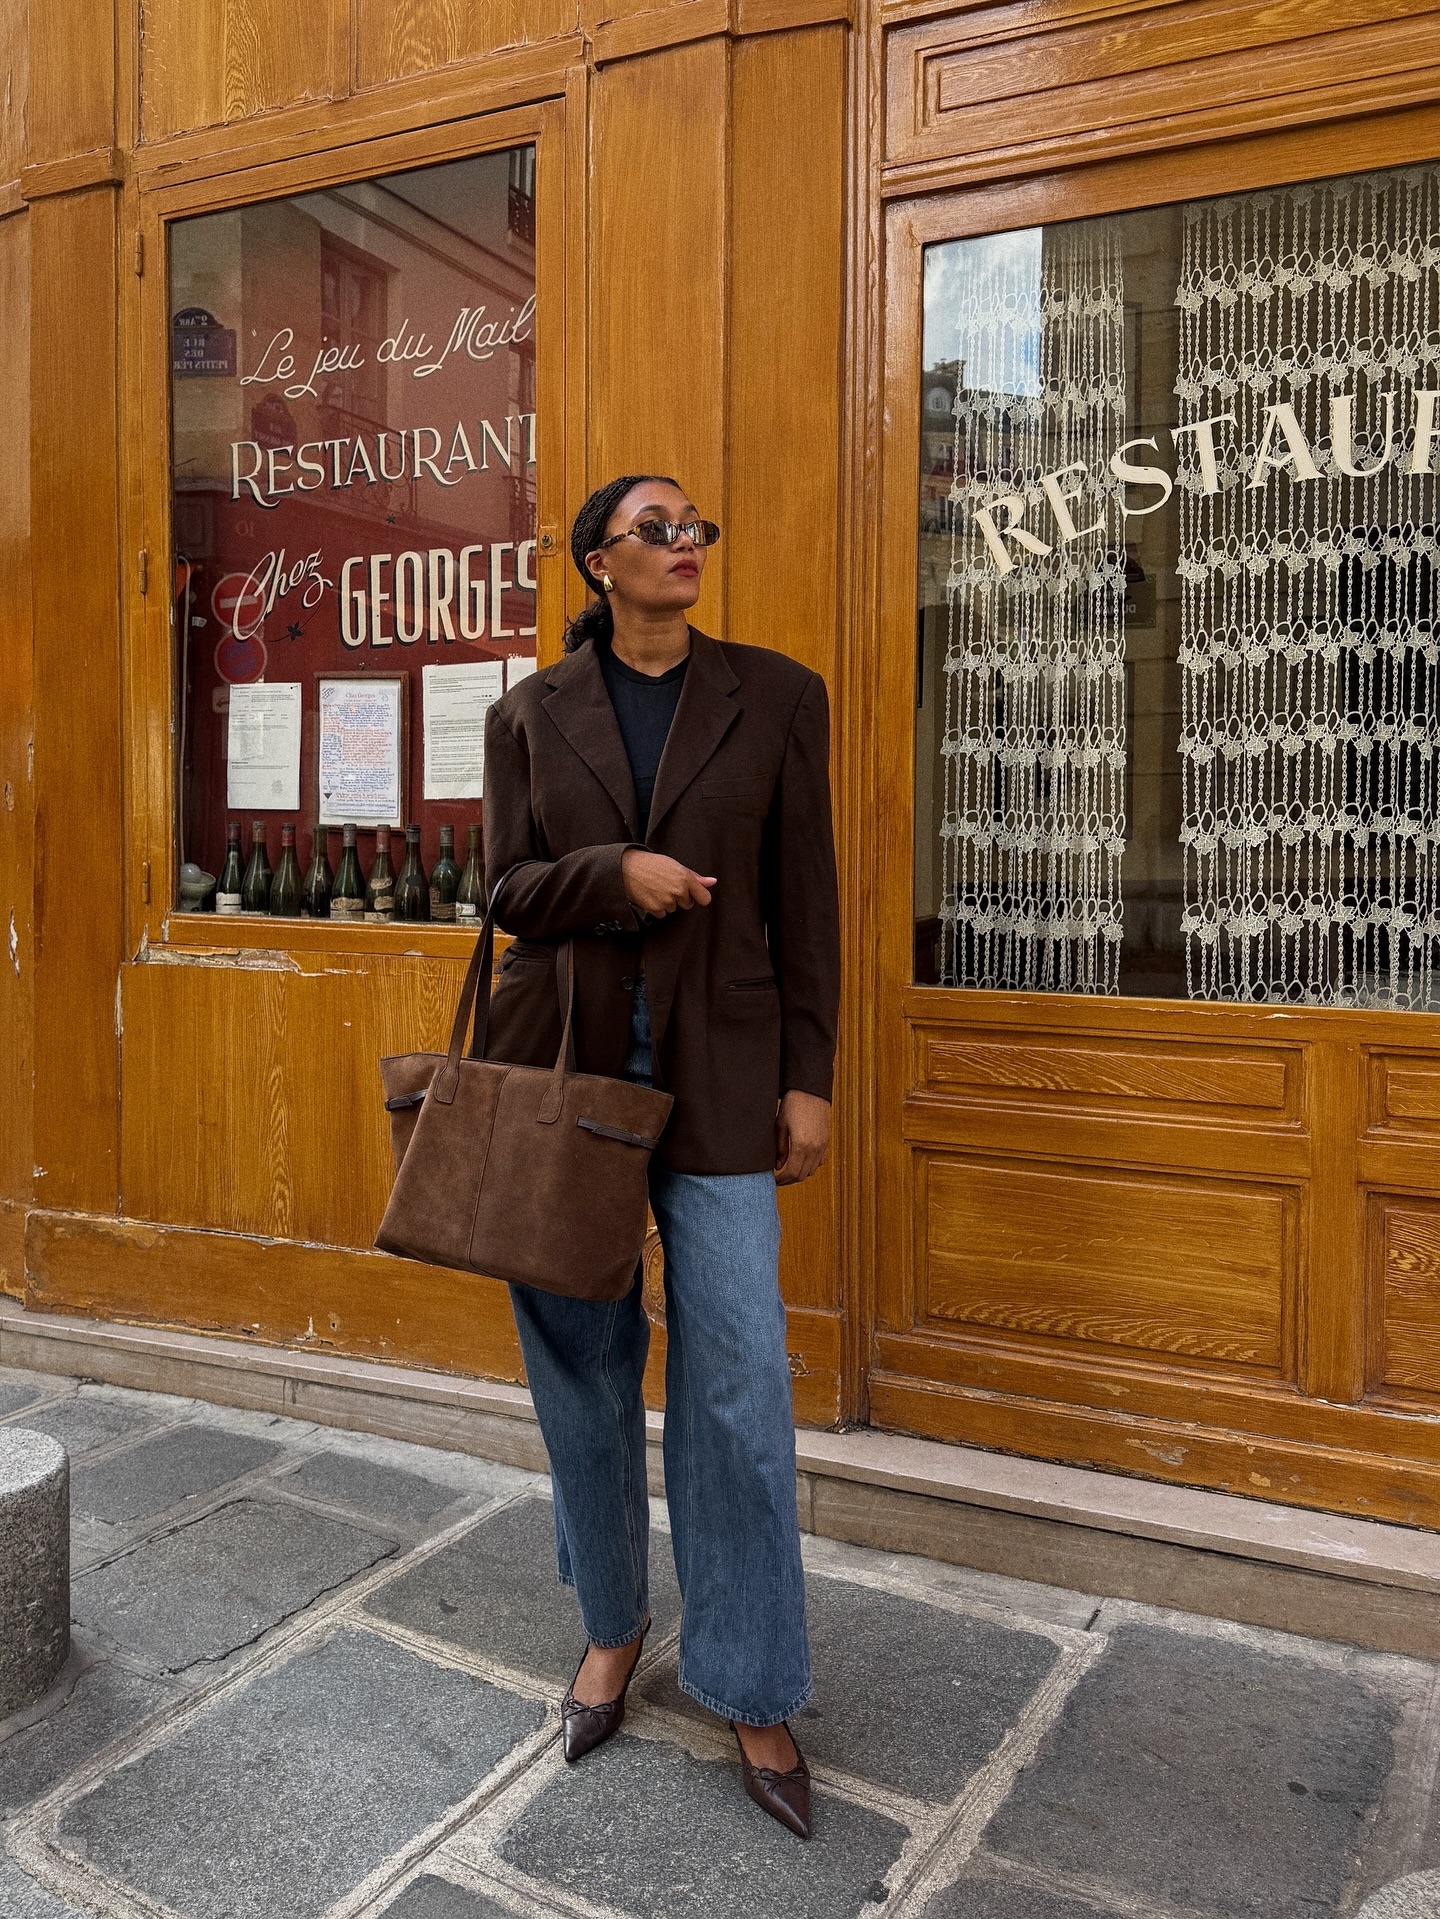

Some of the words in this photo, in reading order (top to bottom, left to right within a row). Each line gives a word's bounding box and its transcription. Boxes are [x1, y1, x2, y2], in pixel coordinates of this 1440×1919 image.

[284, 336, 365, 398] jeu
[375, 318, 433, 364] du
[232, 547, 334, 641] Chez
